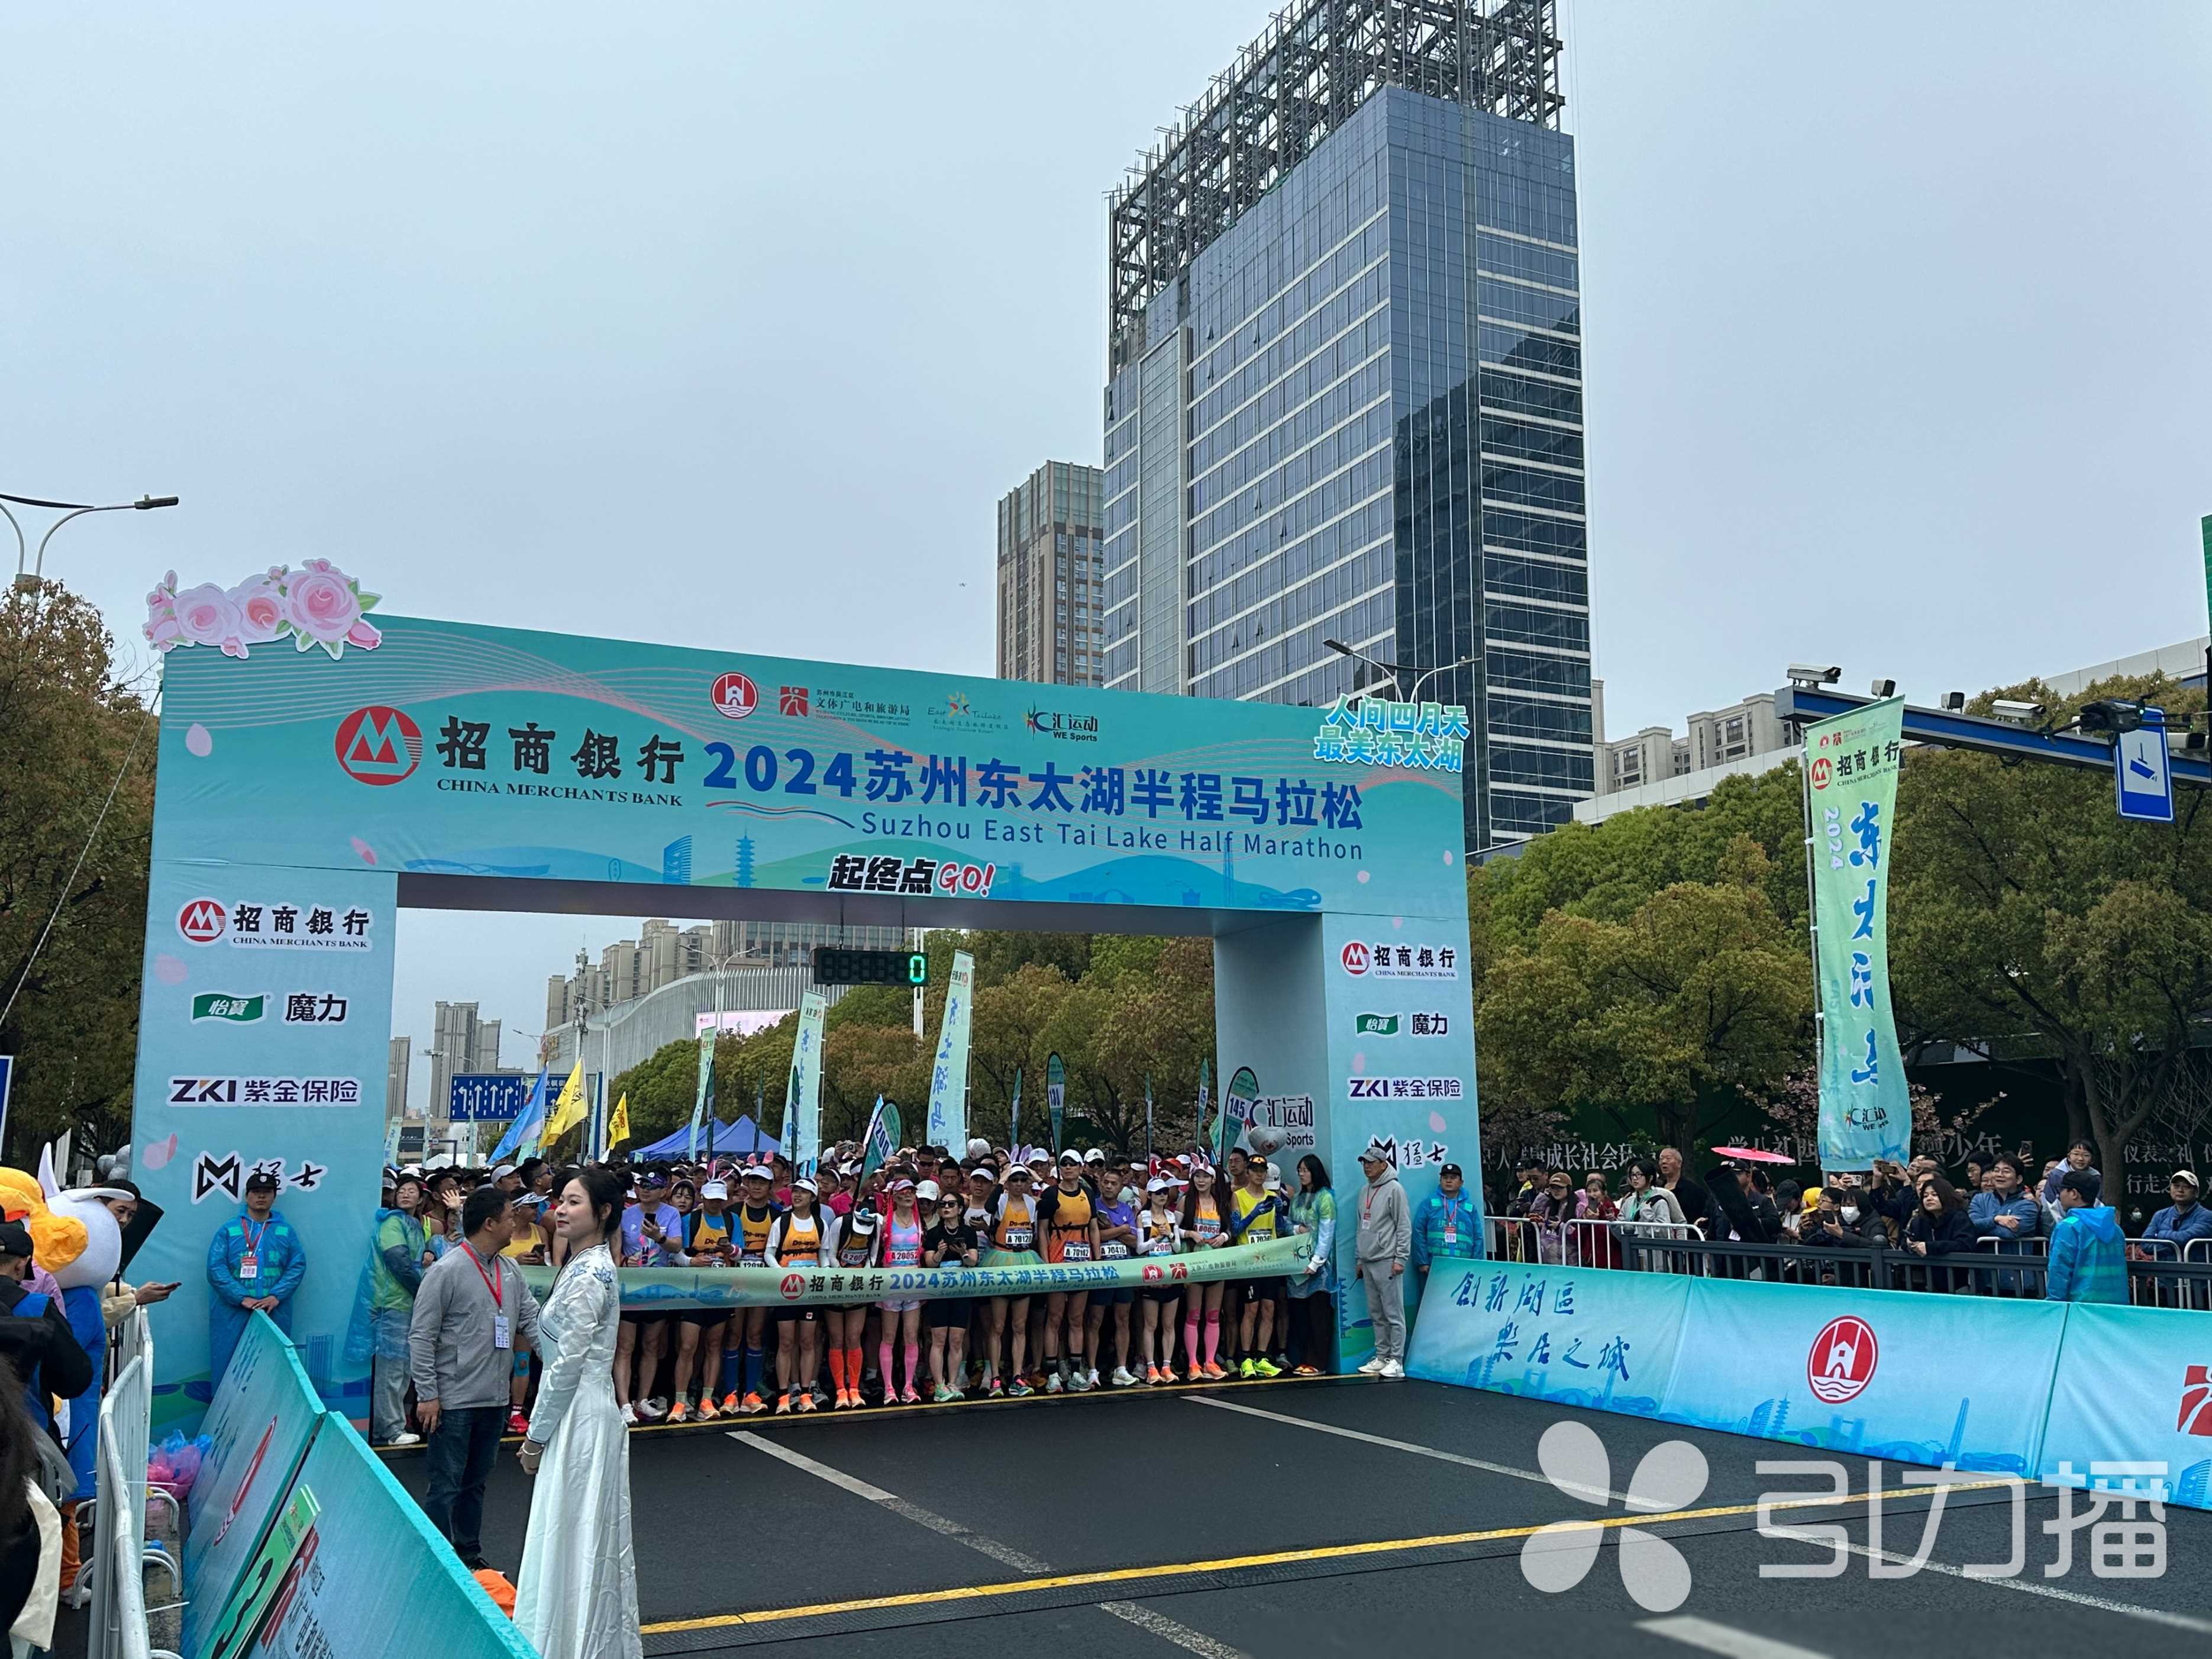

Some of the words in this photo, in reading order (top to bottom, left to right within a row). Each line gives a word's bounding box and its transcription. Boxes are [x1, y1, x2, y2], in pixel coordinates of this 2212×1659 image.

[1052, 712, 1098, 732] 汇运动
[1326, 693, 1470, 739] 人间四月天
[1070, 732, 1097, 742] Sports
[1314, 726, 1464, 772] 最美东太湖
[437, 779, 500, 793] CHINA
[506, 783, 628, 803] MERCHANTS
[632, 791, 684, 807] BANK
[703, 742, 1362, 830] 2024苏州东太湖半程马拉松
[861, 812, 970, 840] Suzhou
[984, 819, 1044, 844] East
[1057, 823, 1096, 846] Tai
[1107, 826, 1168, 850] Lake
[1180, 830, 1233, 853] Half
[1244, 833, 1362, 860] Marathon
[1825, 805, 1844, 870] 2024
[270, 938, 337, 947] MERCHANTS
[910, 956, 925, 983] 0
[286, 993, 347, 1022] 魔力
[1412, 1014, 1448, 1035] 魔力
[170, 1080, 237, 1102] ZKI
[244, 1080, 358, 1102] 紫金保险
[1350, 1079, 1388, 1097] ZKI
[1393, 1080, 1461, 1097] 紫金保险
[1230, 1098, 1245, 1118] 145
[1267, 1097, 1313, 1127] 汇运动
[876, 1121, 889, 1158] 200
[1404, 1142, 1446, 1166] 猛士
[1066, 1250, 1070, 1258] A
[890, 1265, 1120, 1290] 2024苏州东太湖半程马拉松
